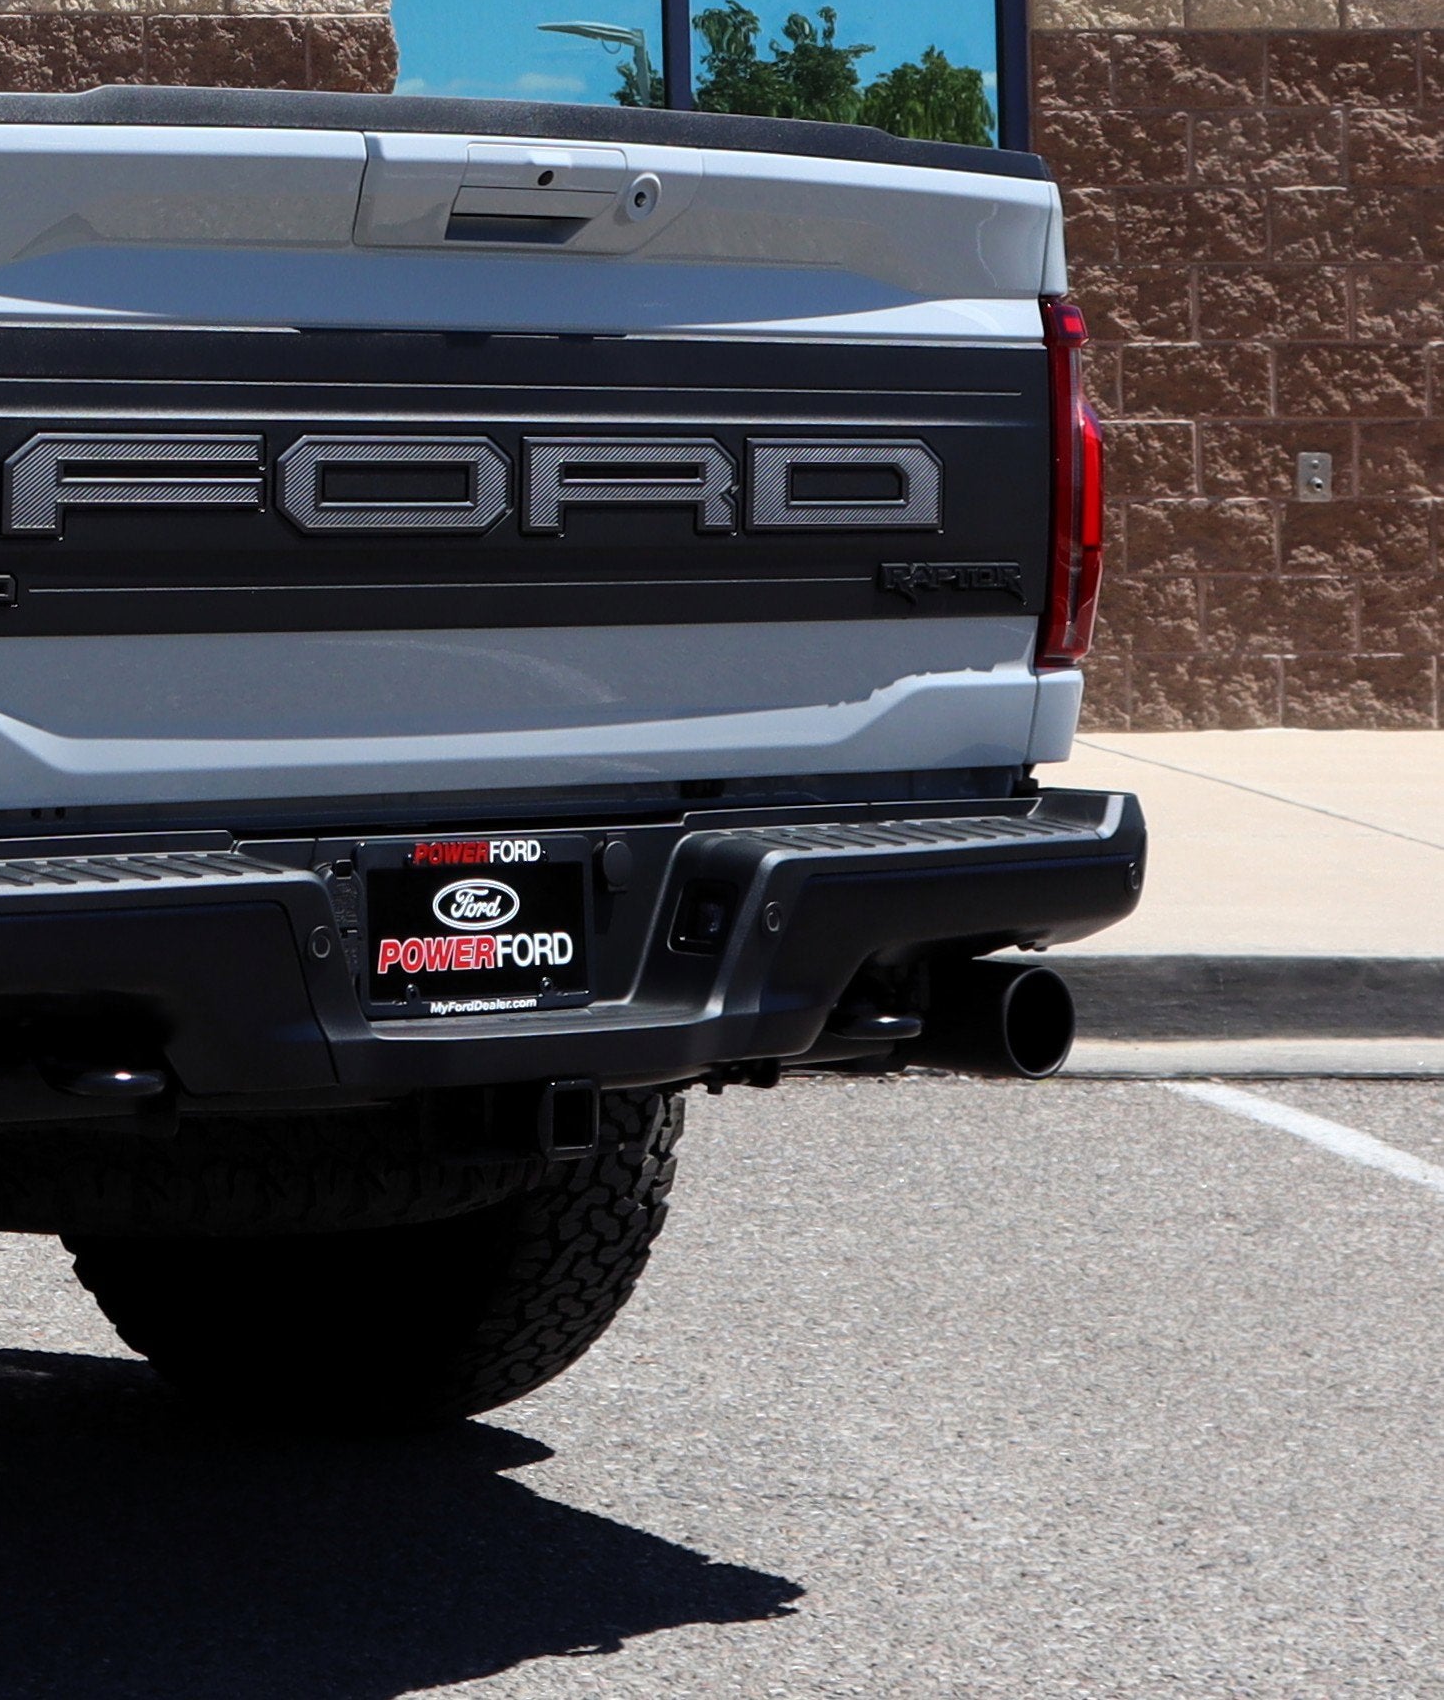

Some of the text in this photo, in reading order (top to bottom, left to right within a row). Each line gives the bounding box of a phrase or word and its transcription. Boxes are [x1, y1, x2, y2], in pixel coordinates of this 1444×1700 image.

[878, 561, 1028, 606] RAPTOR
[450, 888, 502, 919] Ford
[377, 932, 574, 974] POWERFORD
[429, 997, 538, 1015] MyFordDealer.com
